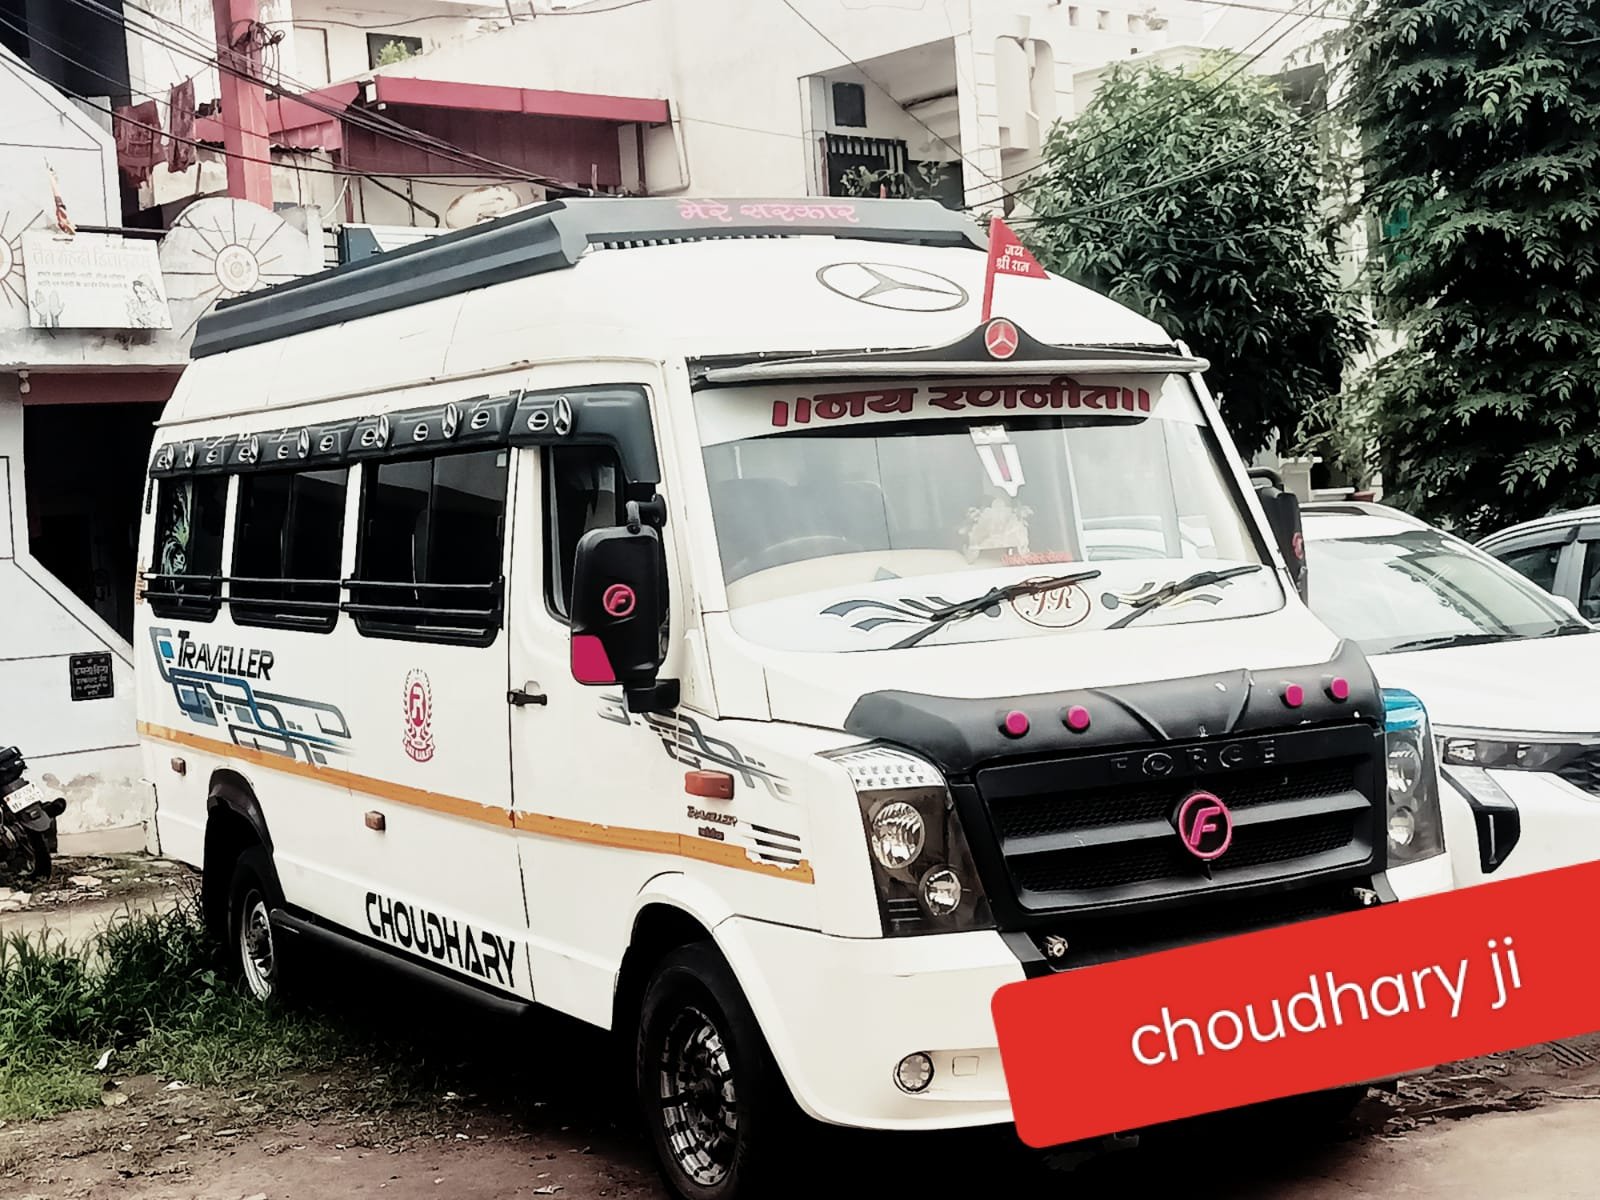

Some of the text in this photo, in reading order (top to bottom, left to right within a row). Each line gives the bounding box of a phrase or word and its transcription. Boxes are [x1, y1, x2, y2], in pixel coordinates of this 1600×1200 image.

[677, 199, 860, 223] मेरे सरकार
[1004, 244, 1025, 257] जय
[996, 255, 1031, 273] श्री राम
[365, 891, 516, 989] CHOUDHARY
